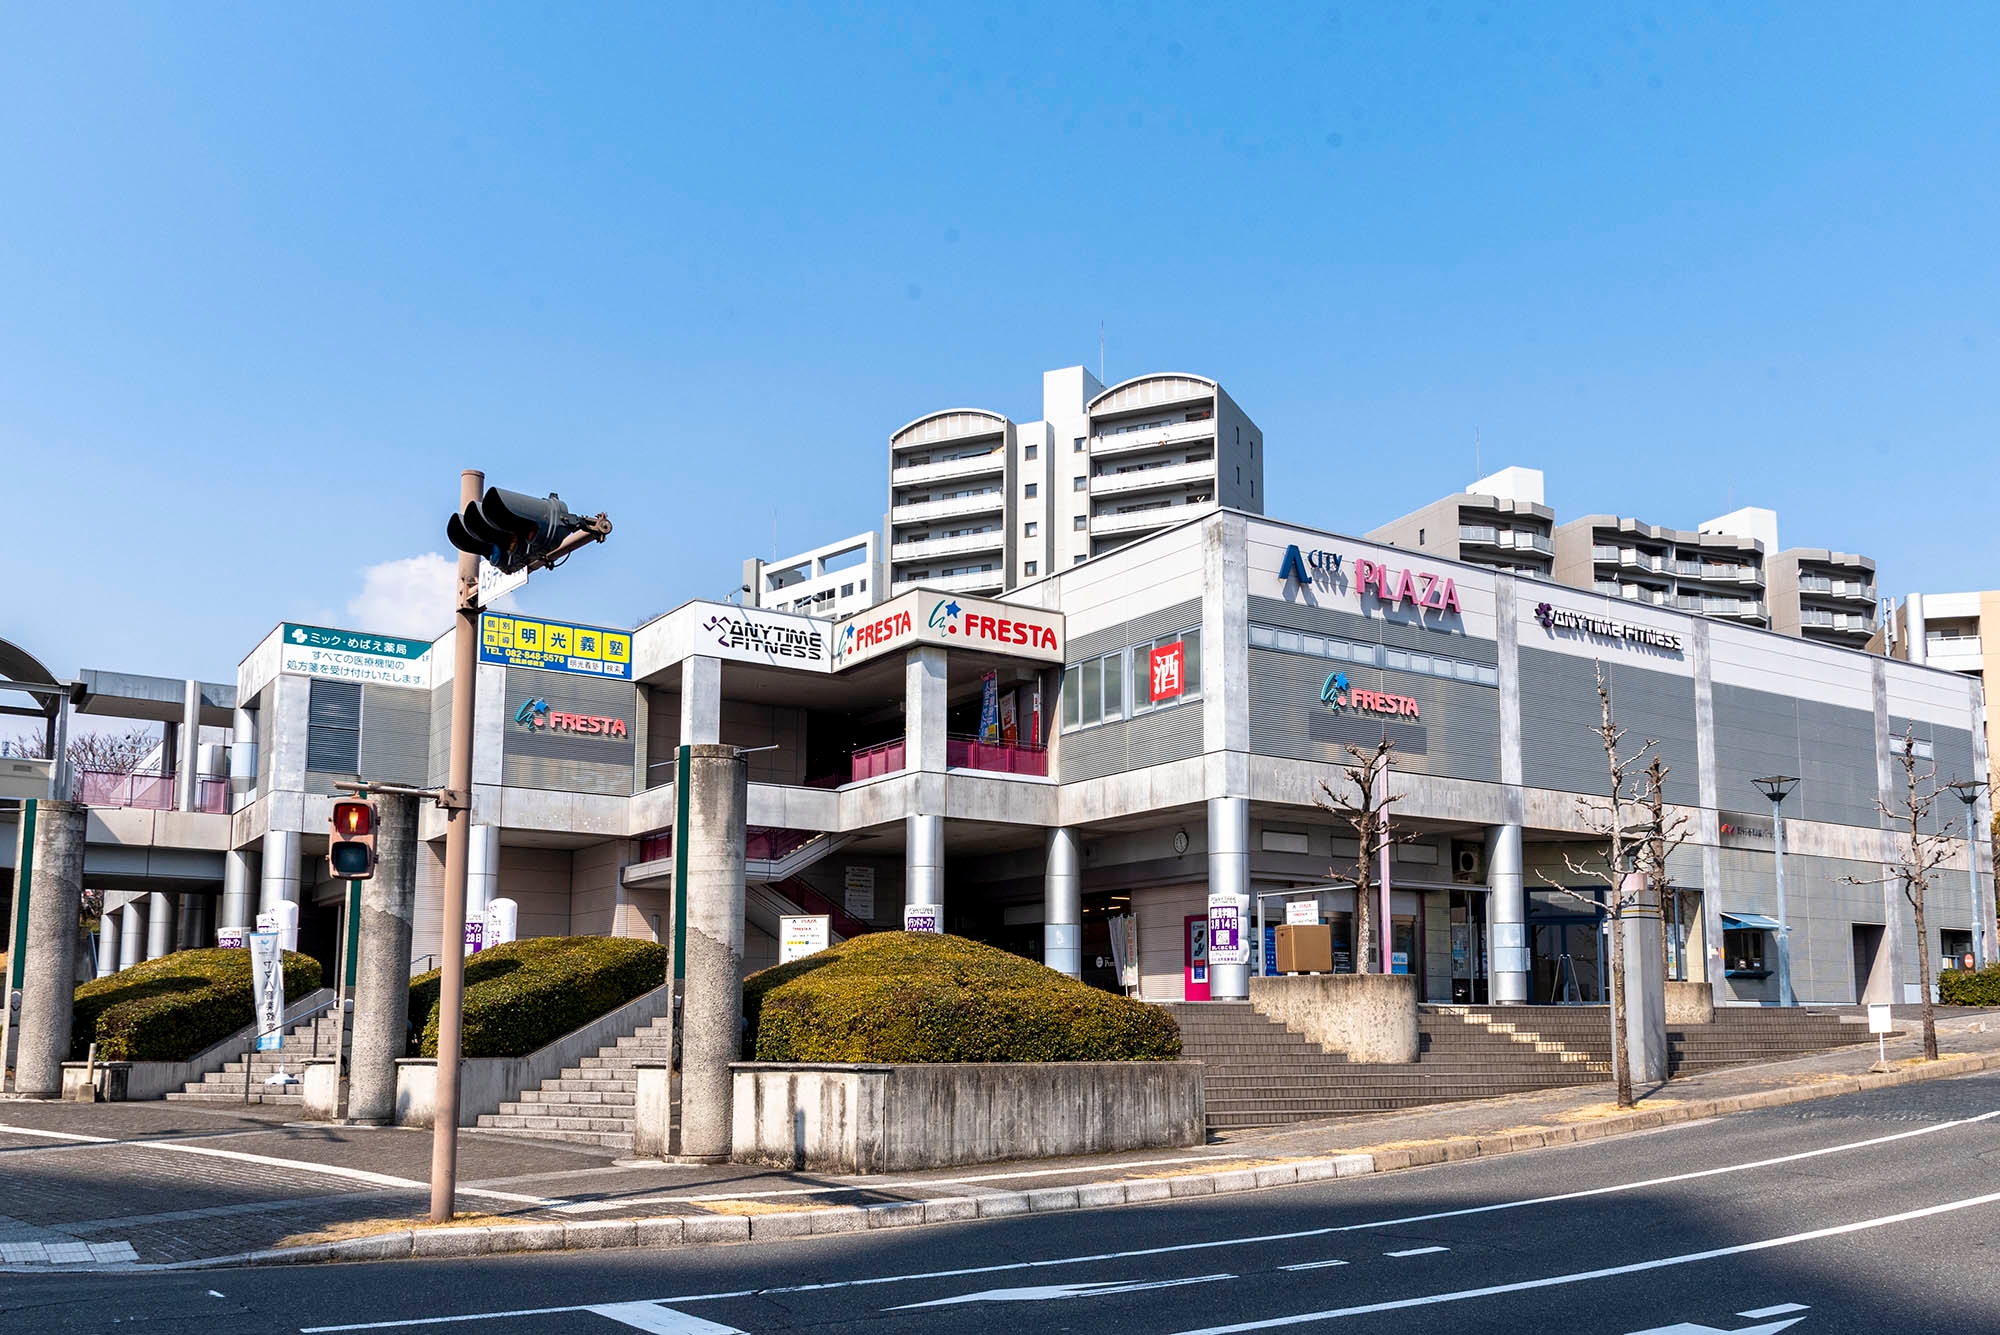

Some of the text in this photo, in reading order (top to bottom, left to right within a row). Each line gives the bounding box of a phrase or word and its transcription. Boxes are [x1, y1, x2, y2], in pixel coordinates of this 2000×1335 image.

[1278, 544, 1461, 613] A CITY PLAZA
[521, 628, 623, 656] 明光義塾
[730, 621, 822, 647] ANYTIME
[857, 610, 911, 649] FRESTA
[965, 613, 1057, 651] FRESTA
[1554, 610, 1684, 650] ANYTIME FITNESS
[310, 632, 407, 655] ミック・めばえ薬局
[484, 646, 502, 656] TEL
[505, 649, 565, 663] 082-848-5578
[731, 638, 821, 660] FITNESS
[311, 651, 405, 670] すべての医療機関の
[1153, 649, 1179, 694] 酒
[1351, 688, 1419, 717] FRESTA
[550, 711, 627, 736] FRESTA
[1210, 919, 1237, 930] 3月14日
